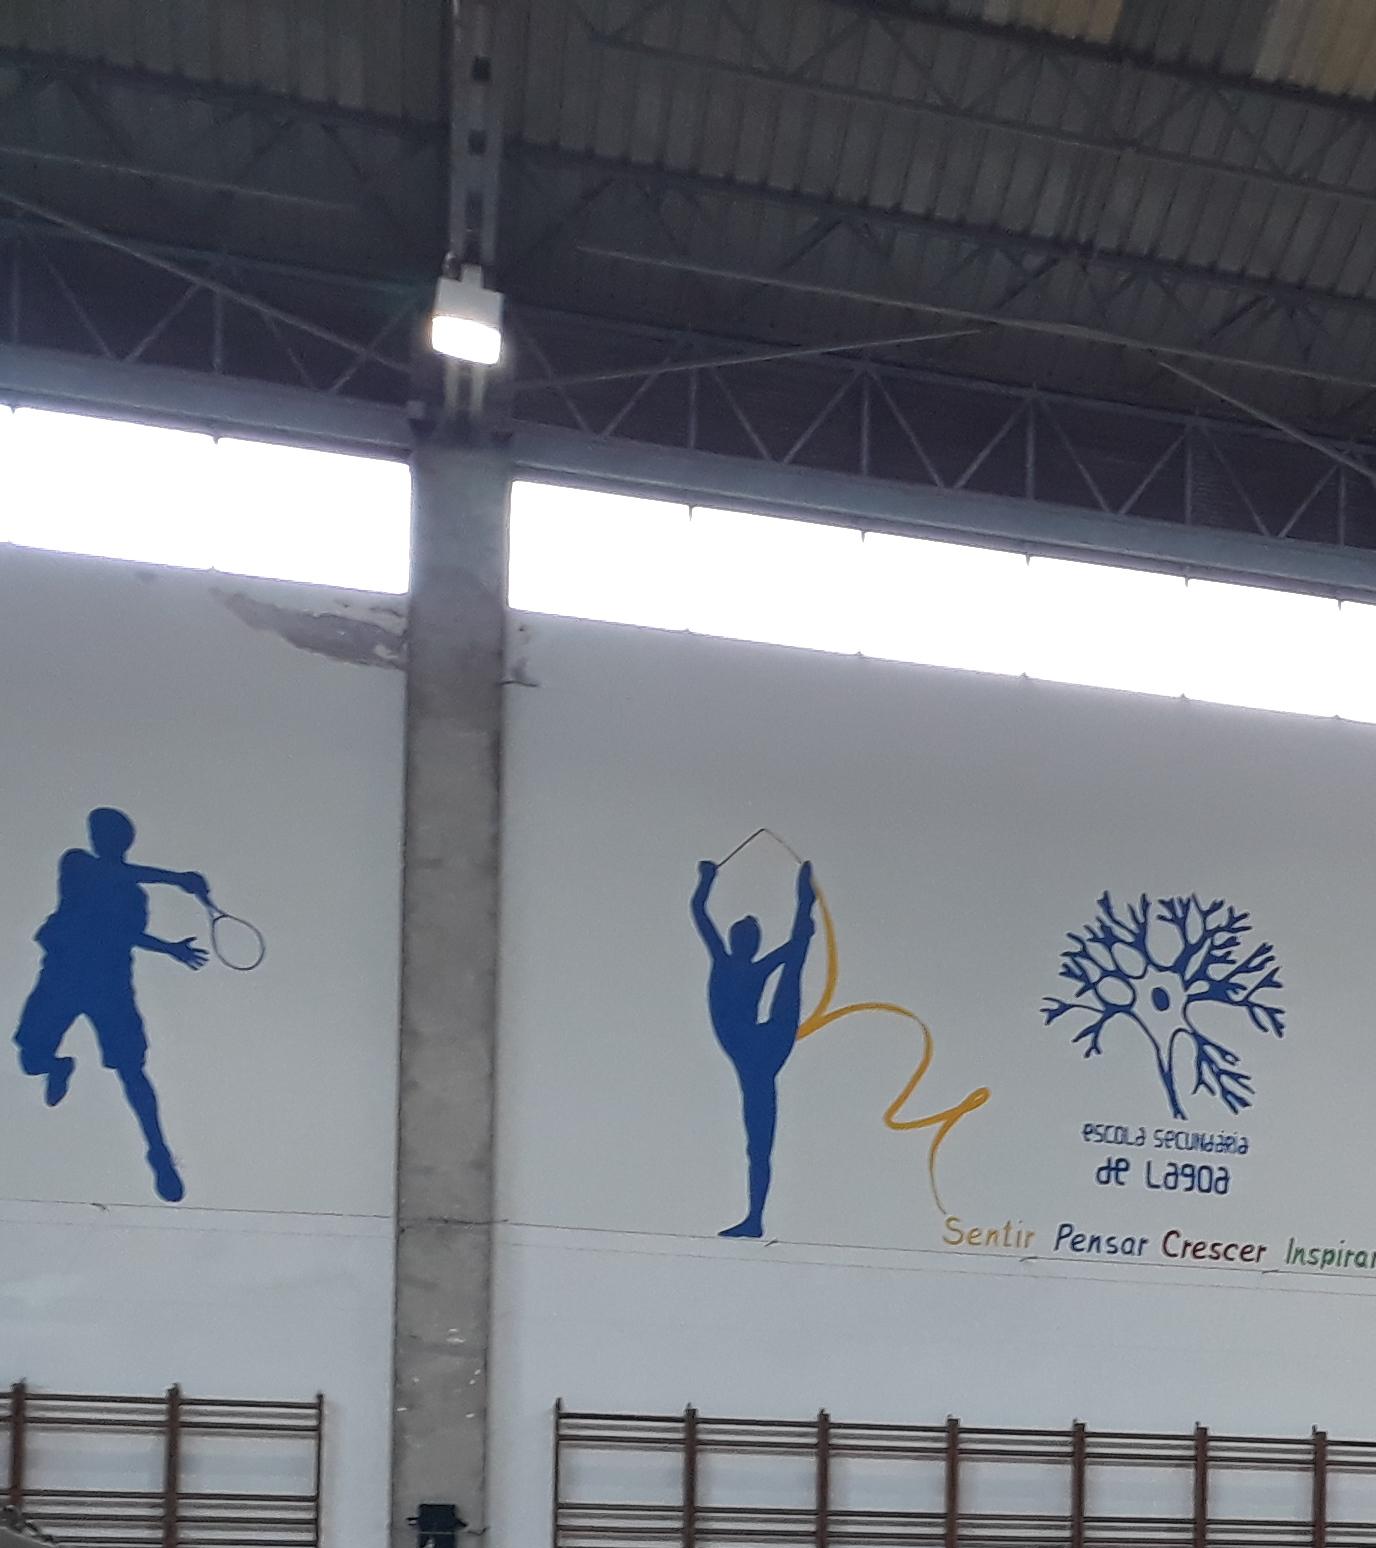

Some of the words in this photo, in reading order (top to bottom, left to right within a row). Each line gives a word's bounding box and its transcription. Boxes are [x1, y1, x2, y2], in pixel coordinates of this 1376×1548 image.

[1095, 1156, 1131, 1186] de
[1146, 1160, 1231, 1195] Lagoa
[942, 1215, 1036, 1249] Sentir
[1053, 1222, 1150, 1256] Pensar
[1161, 1229, 1268, 1264] Crescer
